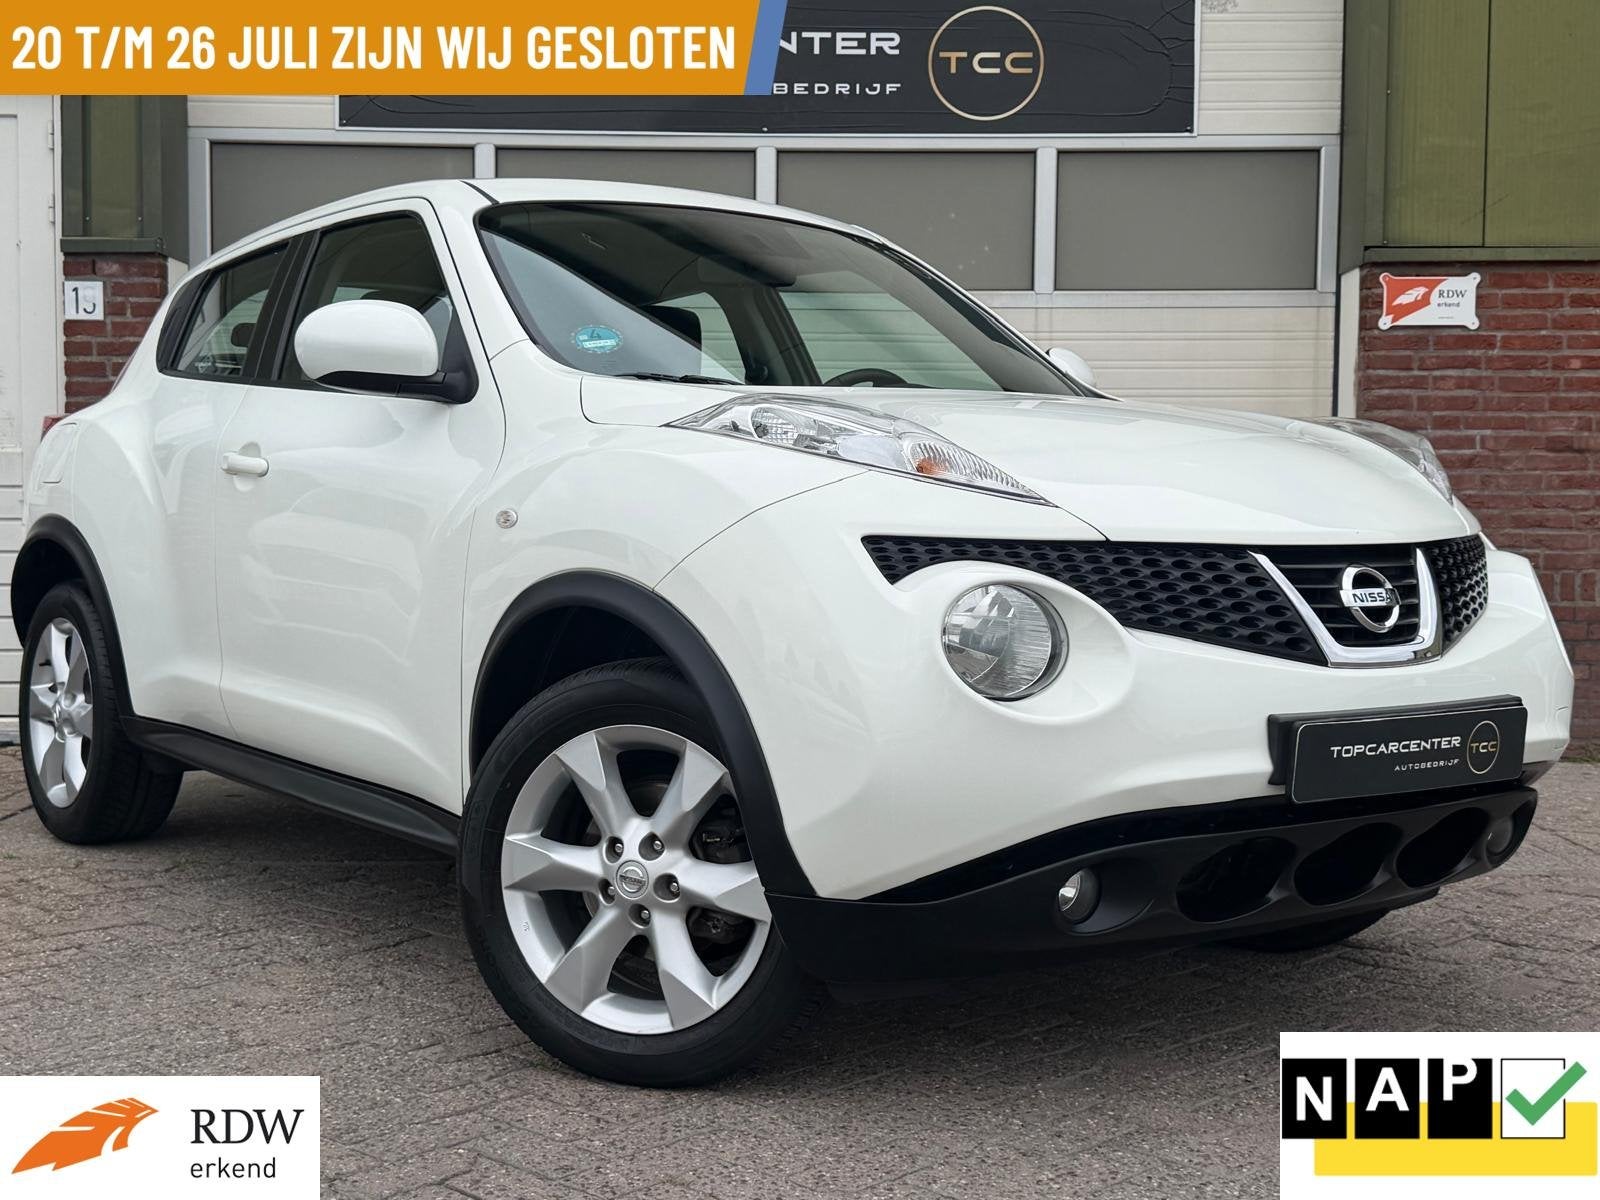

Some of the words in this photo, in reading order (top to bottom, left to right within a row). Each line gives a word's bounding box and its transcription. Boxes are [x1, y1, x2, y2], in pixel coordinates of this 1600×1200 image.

[939, 51, 1033, 74] TCC
[1438, 289, 1467, 298] RDW
[1330, 736, 1461, 758] TOPCARCENTER
[1471, 741, 1497, 753] TCC
[1394, 758, 1460, 771] AUTOBEDRIJF
